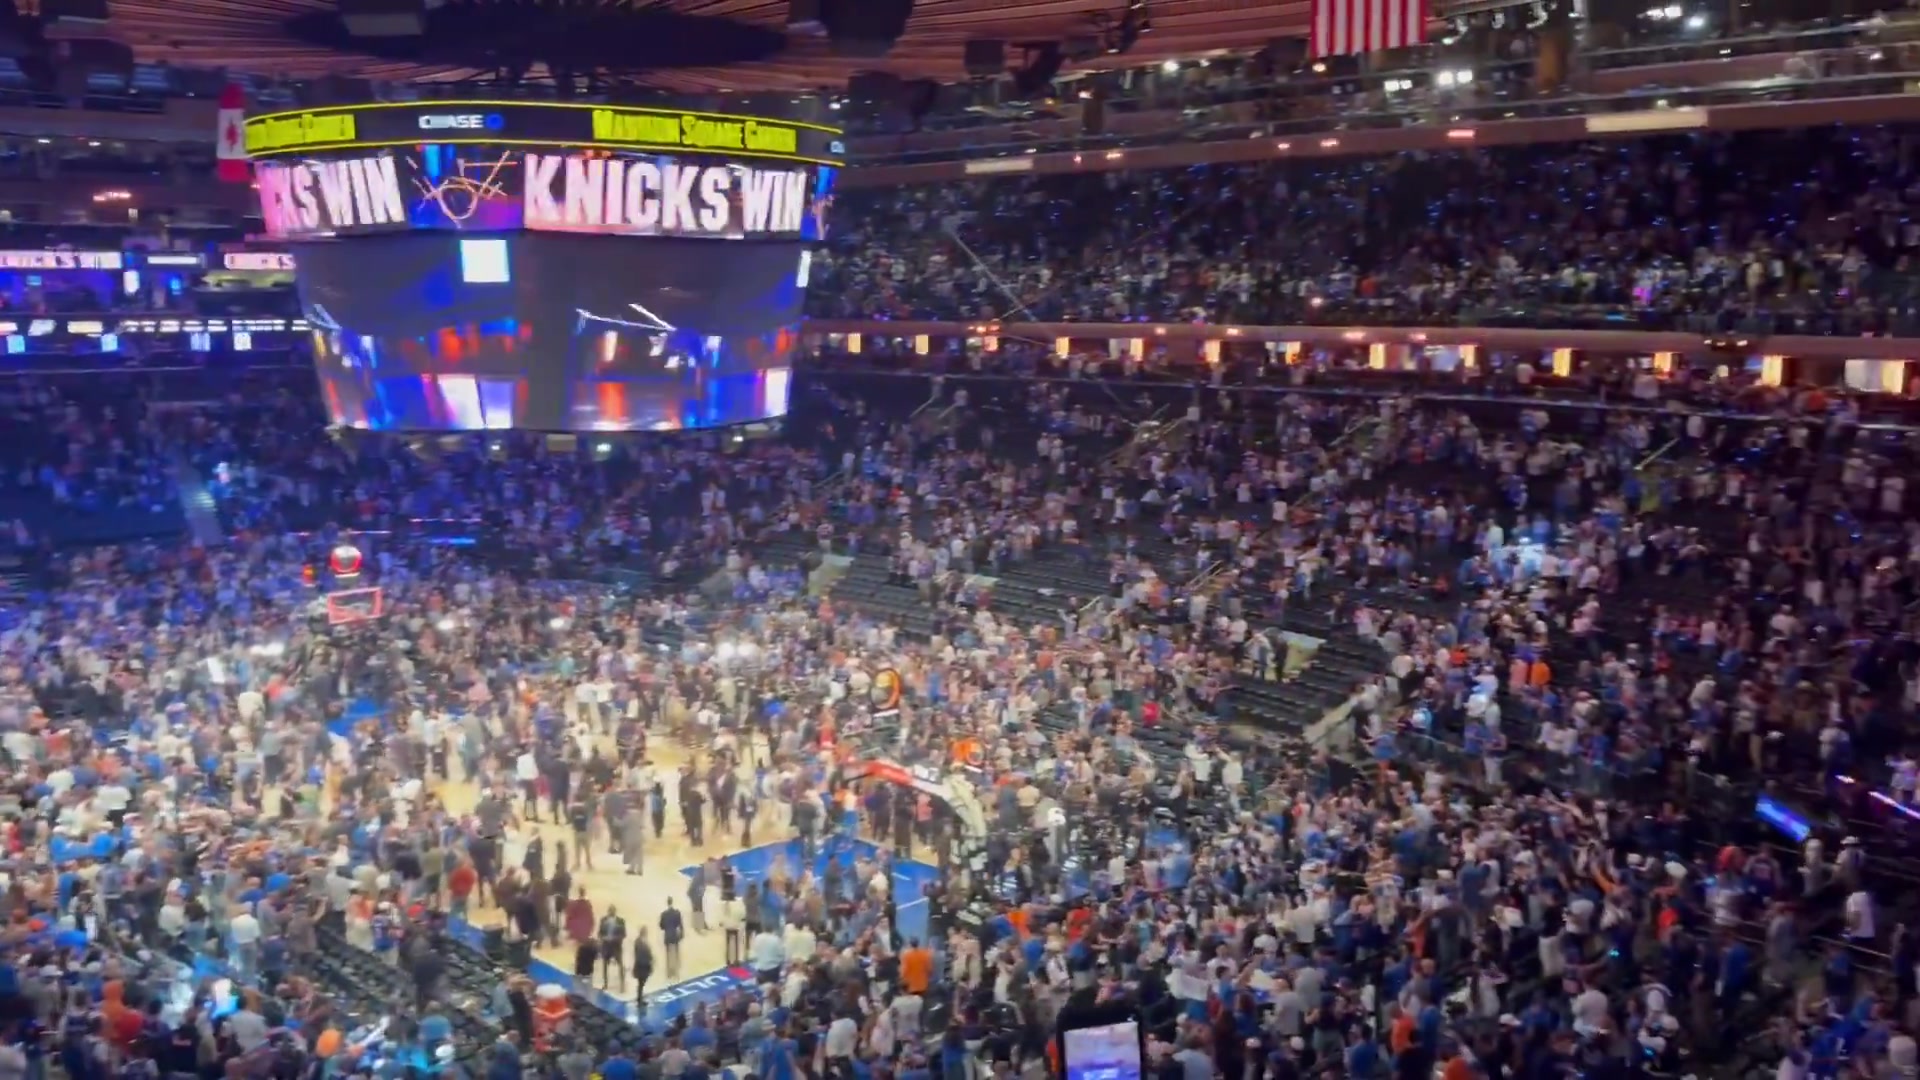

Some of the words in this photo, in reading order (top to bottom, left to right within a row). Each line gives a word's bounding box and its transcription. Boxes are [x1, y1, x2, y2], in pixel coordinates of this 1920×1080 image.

[319, 156, 405, 226] WIN
[524, 154, 731, 231] KNICKS
[741, 168, 806, 232] WIN
